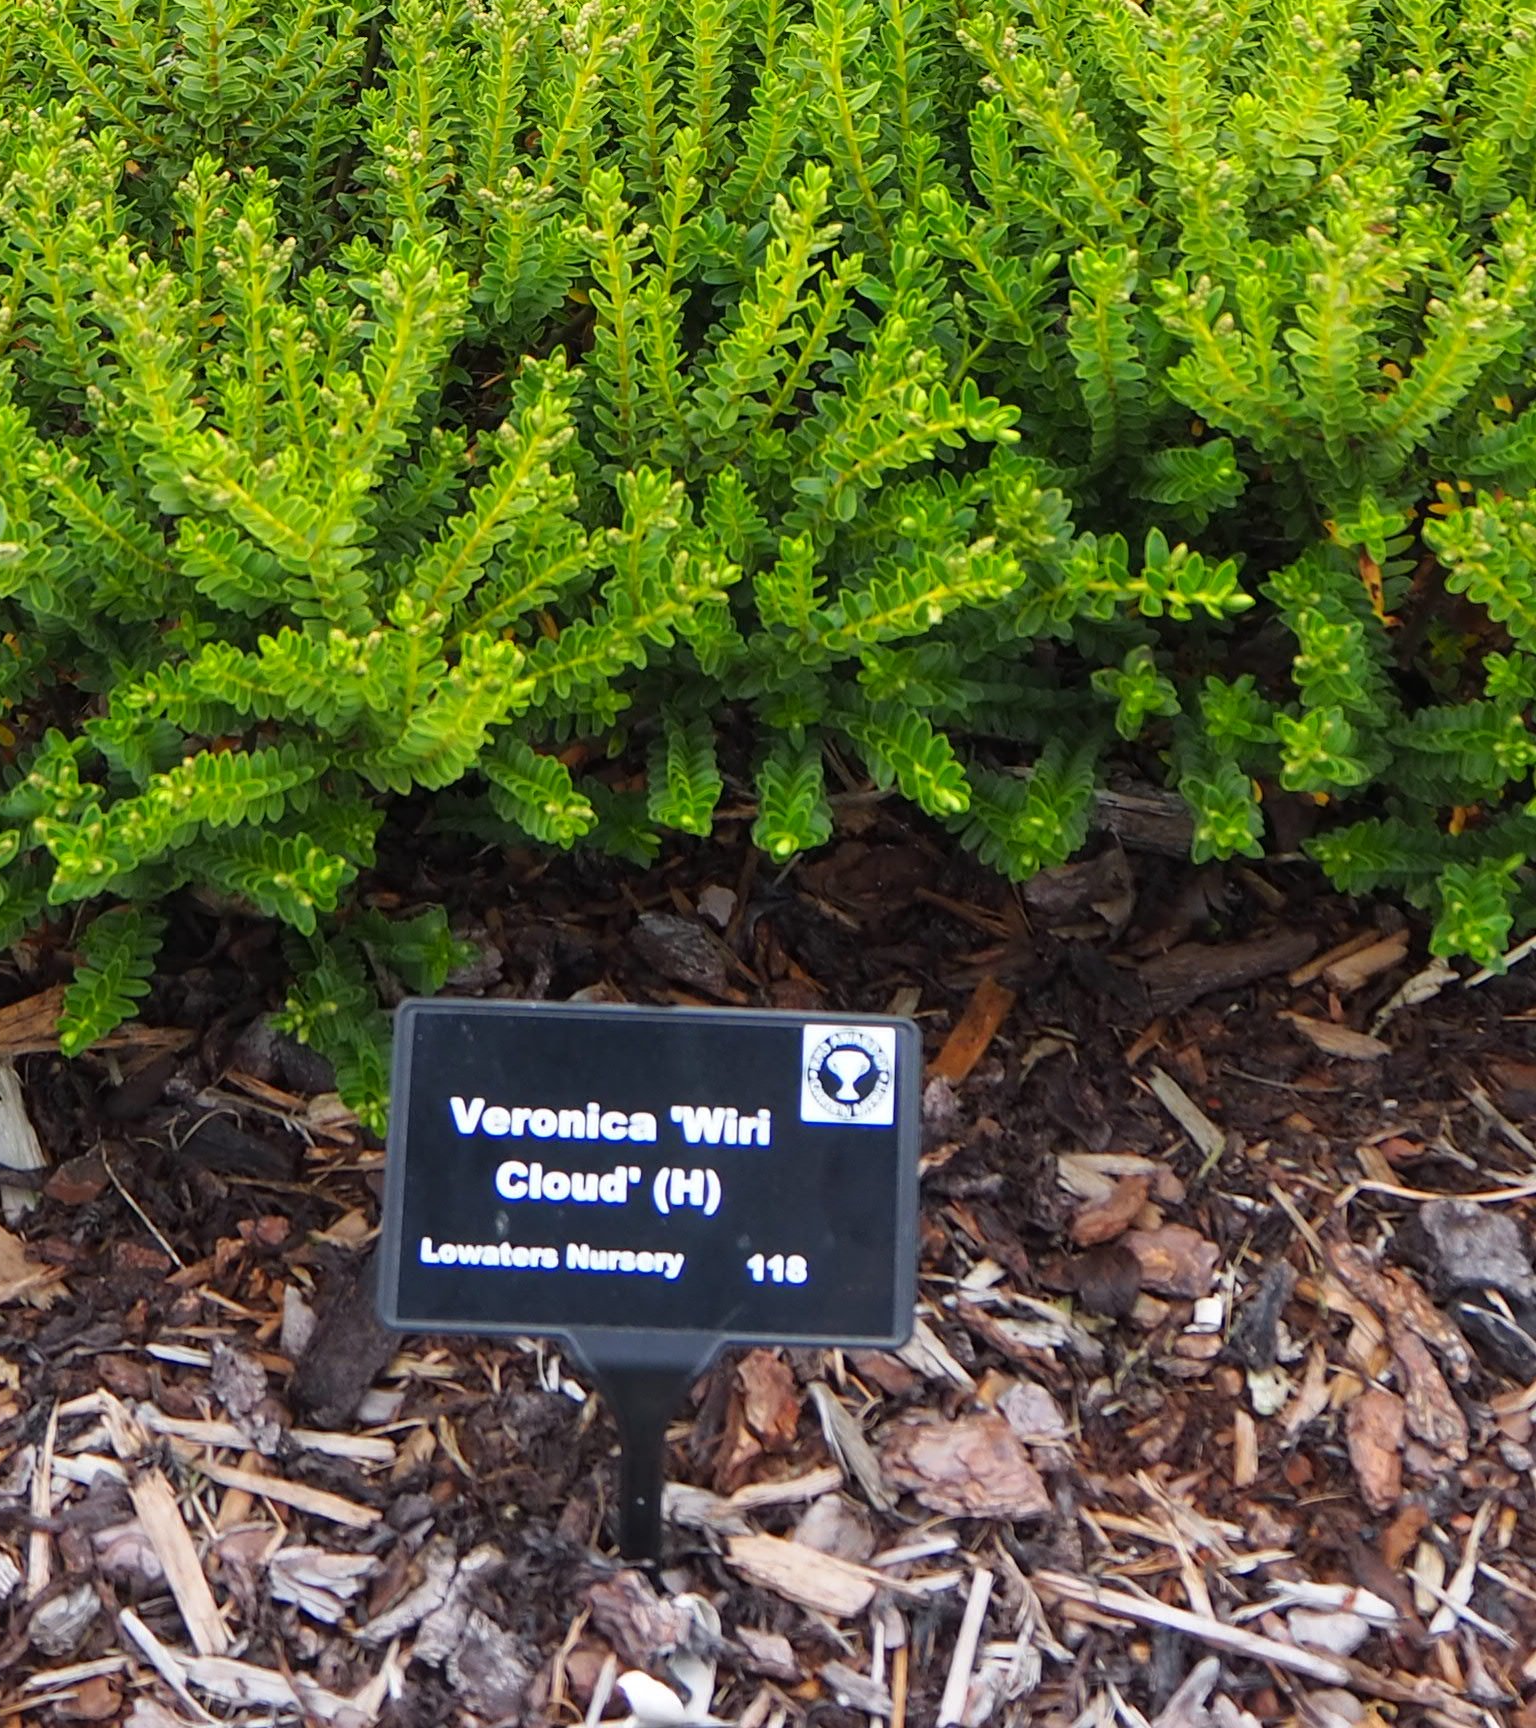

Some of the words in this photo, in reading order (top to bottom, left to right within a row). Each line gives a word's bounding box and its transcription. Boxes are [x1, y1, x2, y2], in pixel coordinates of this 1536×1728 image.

[450, 1096, 657, 1142] Veronica
[670, 1105, 771, 1146] 'Wiri
[495, 1160, 642, 1204] Cloud'
[653, 1166, 722, 1215] (H)
[420, 1236, 559, 1270] Lowaters
[566, 1243, 685, 1280] Nursery
[746, 1253, 808, 1284] 118
